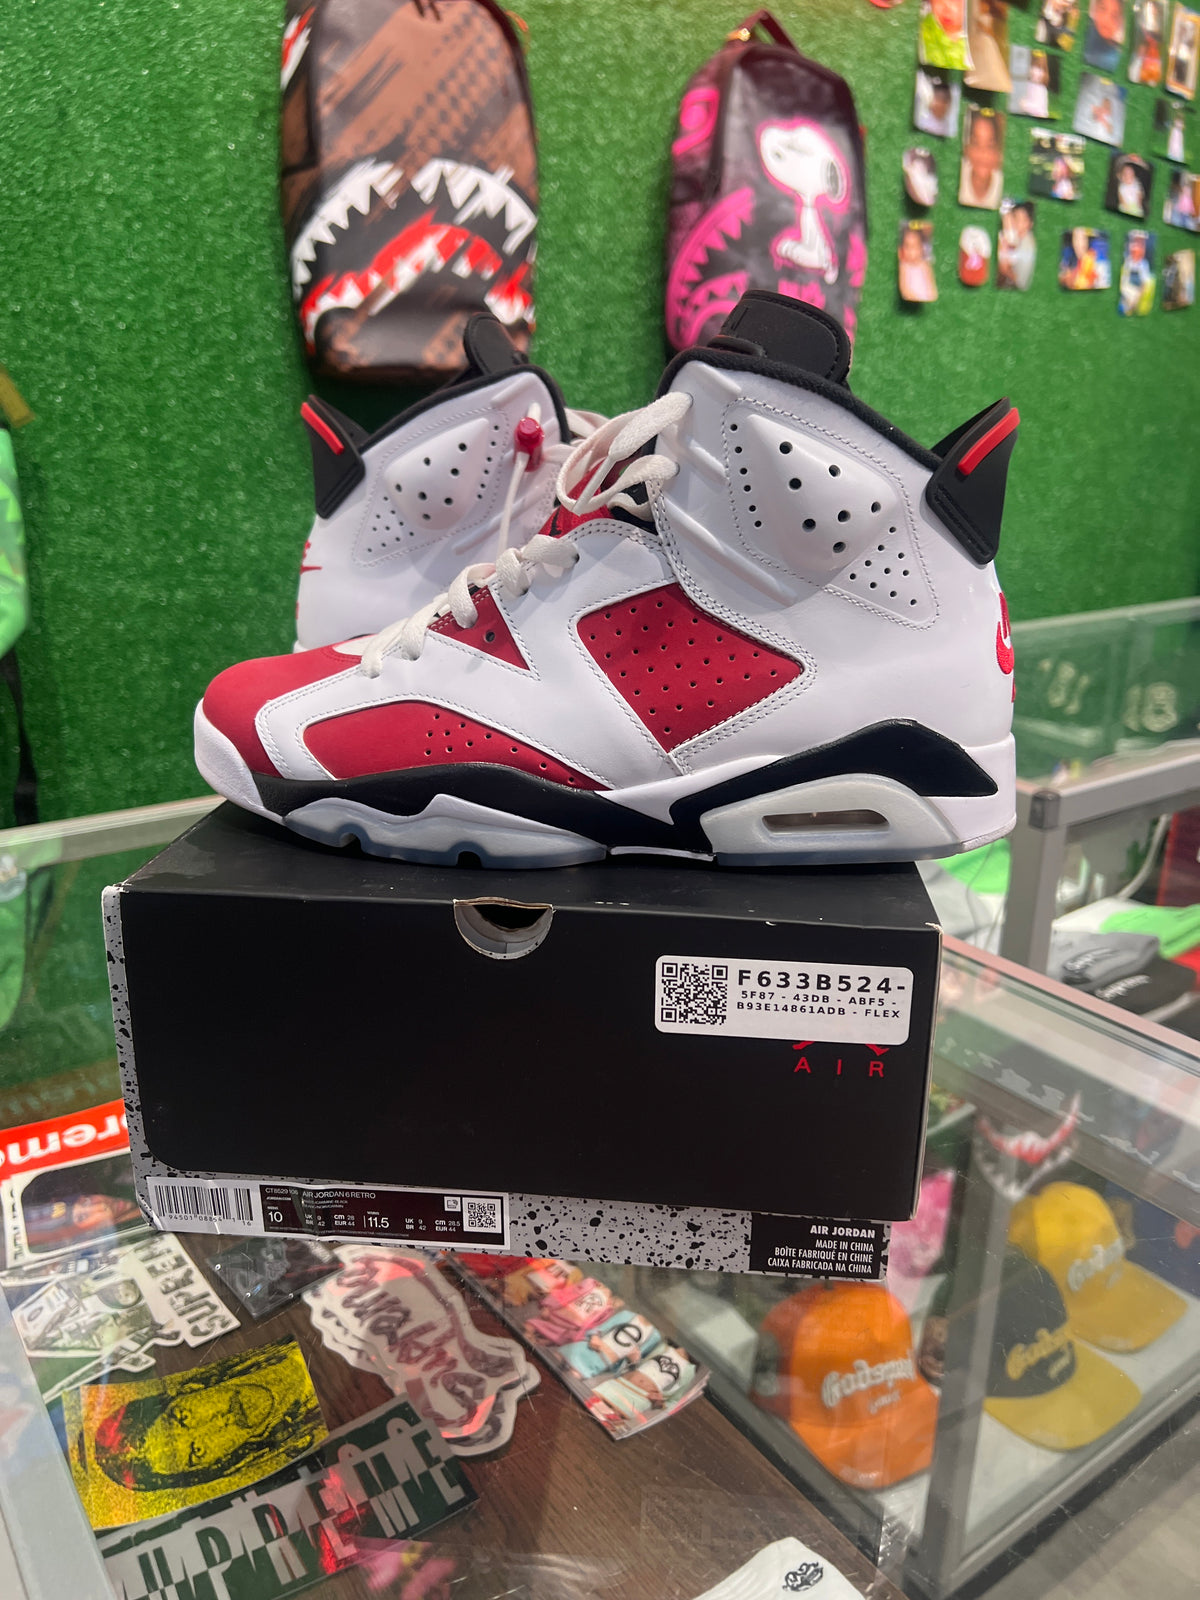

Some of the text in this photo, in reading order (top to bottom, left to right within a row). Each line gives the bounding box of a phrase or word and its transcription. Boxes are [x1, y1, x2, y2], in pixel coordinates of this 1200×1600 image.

[738, 968, 906, 994] F633B524-
[741, 990, 775, 1000] 5F87
[793, 992, 830, 1004] 43DB
[848, 996, 886, 1006] ABF5
[736, 1001, 846, 1016] B93E14861ADB
[865, 1008, 901, 1018] FLEX
[794, 1056, 885, 1078] AIR
[0, 1113, 128, 1168] rem
[268, 1211, 283, 1223] 10
[368, 1217, 390, 1228] 11.5
[810, 1225, 876, 1238] AIR JORDAN
[816, 1239, 874, 1252] MADE IN CHINA
[775, 1246, 873, 1263] BOÎTE FABRIQUÉ EN CHINE
[767, 1257, 872, 1274] CAIXA FABRICADA NA CHINA
[128, 1429, 466, 1600] UPREME
